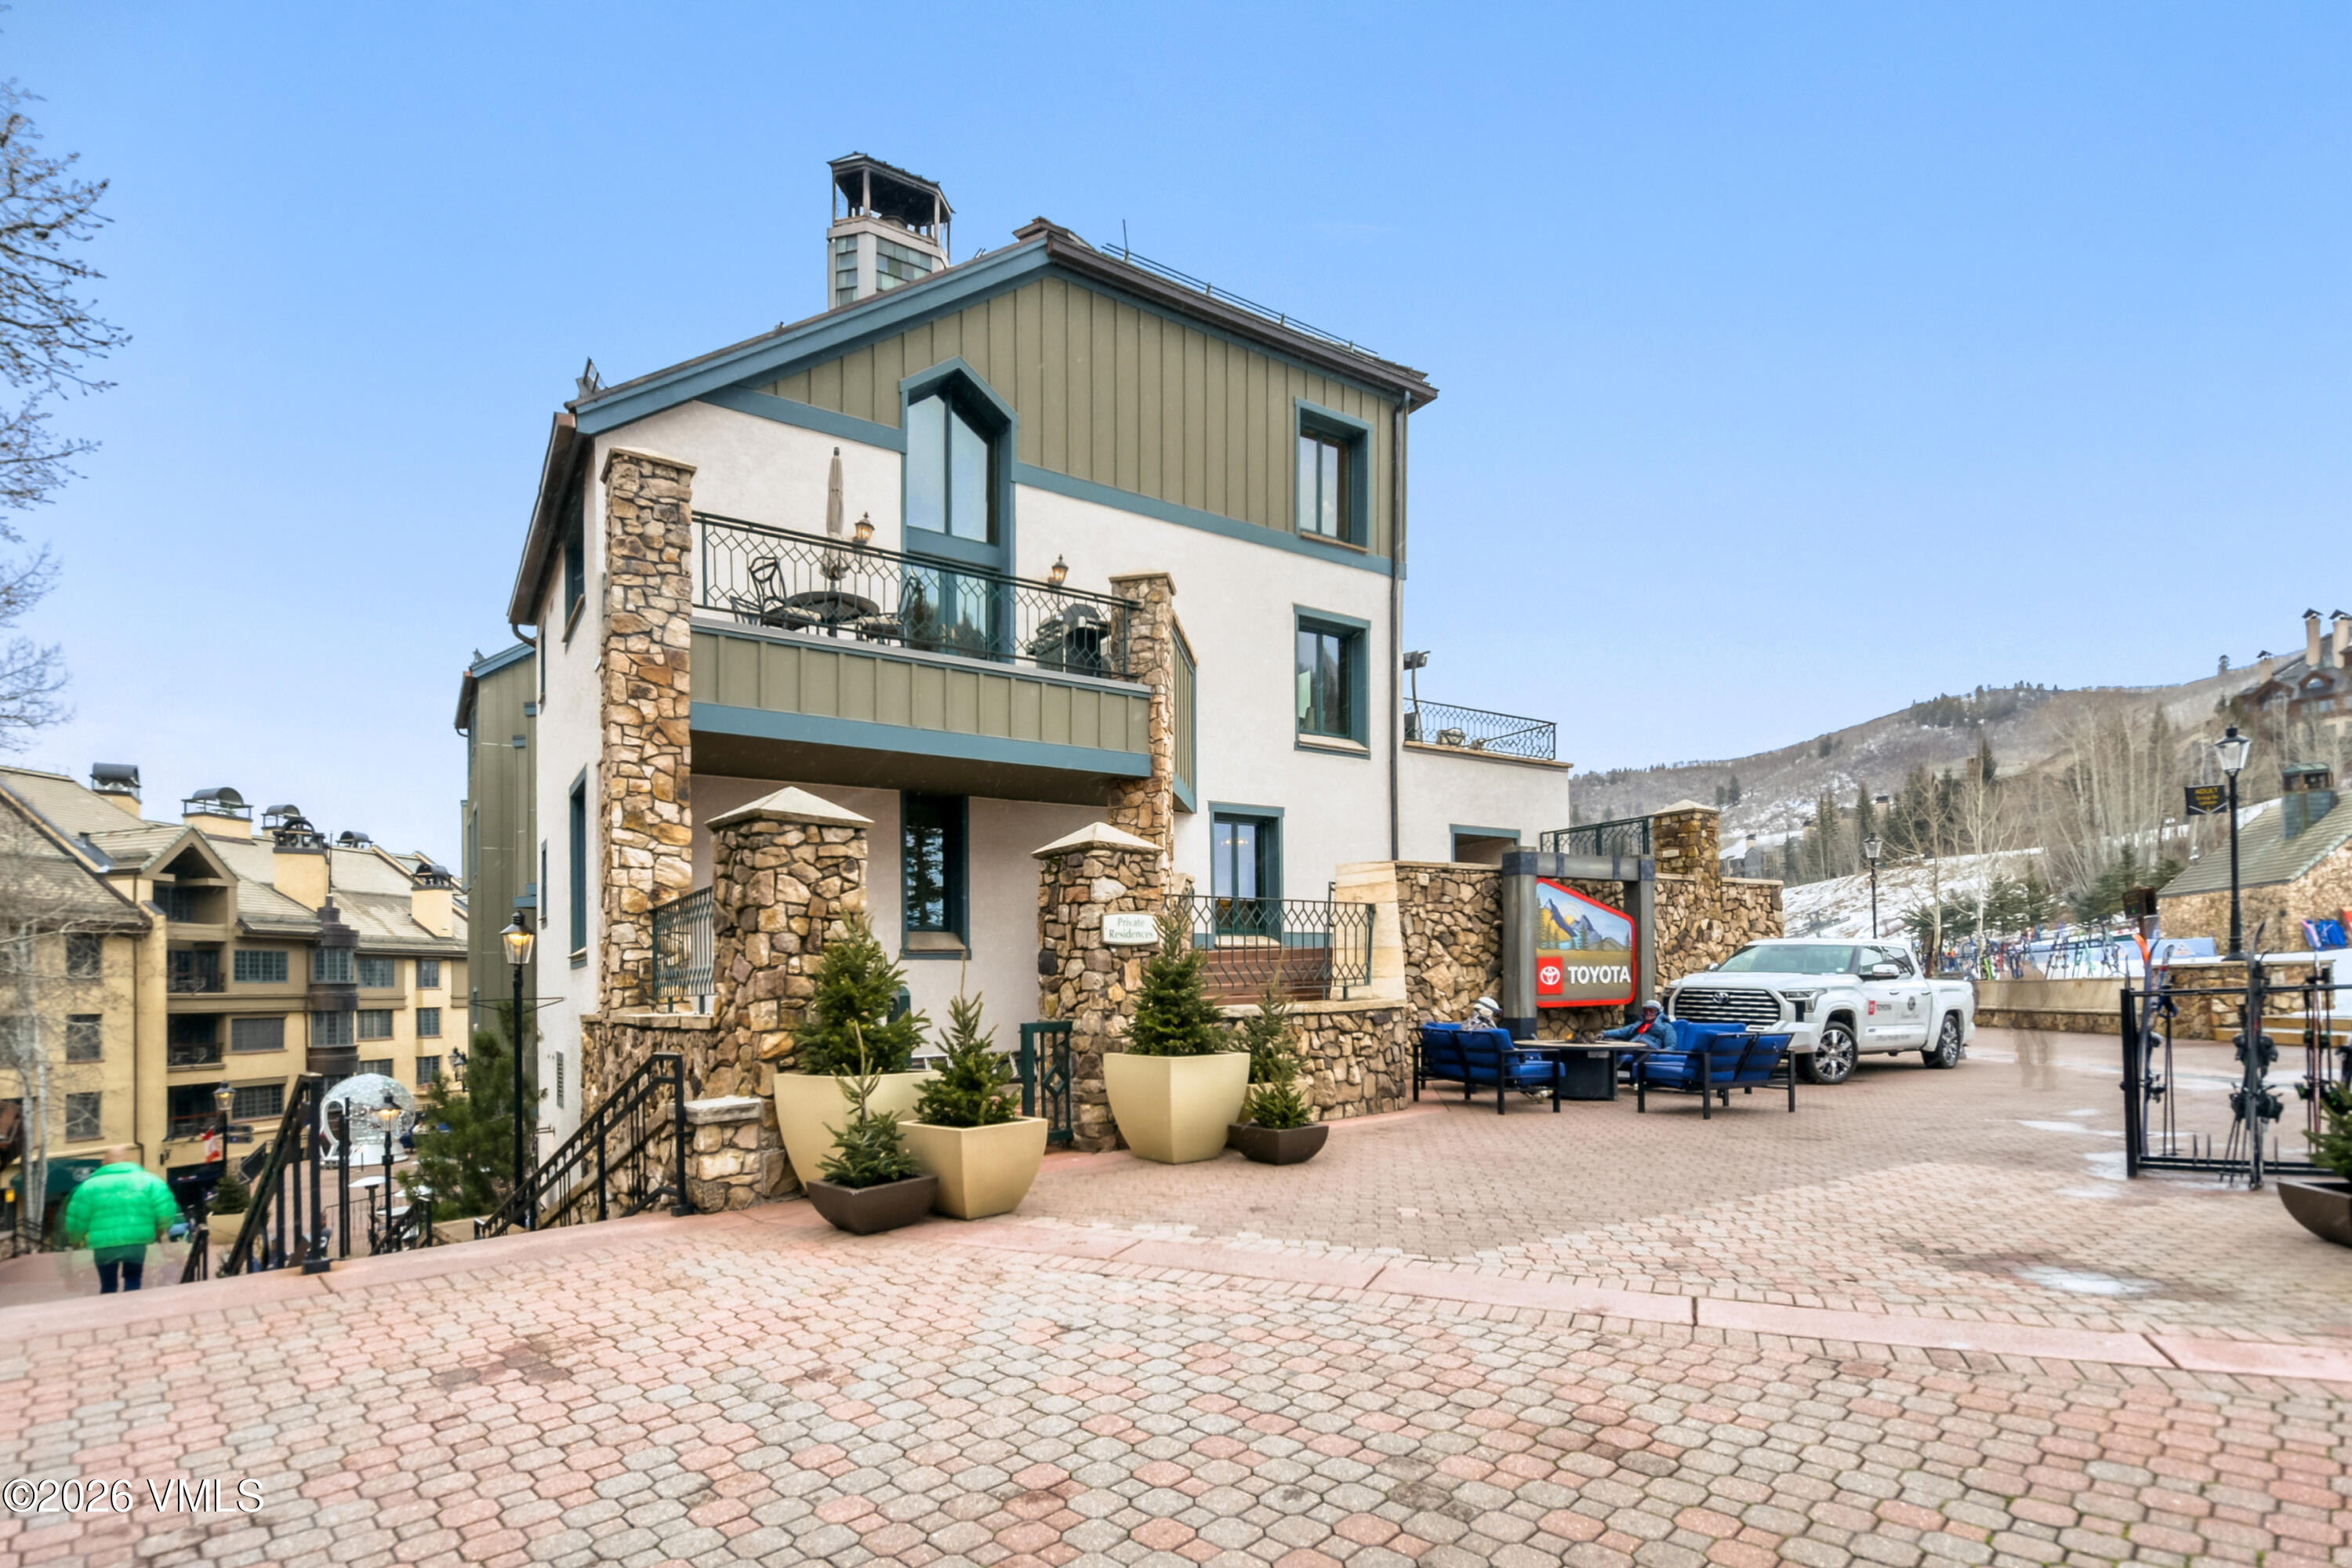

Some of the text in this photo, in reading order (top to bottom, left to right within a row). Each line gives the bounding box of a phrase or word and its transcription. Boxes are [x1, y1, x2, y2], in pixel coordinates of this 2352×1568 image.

[1117, 917, 1145, 927] Private
[1109, 928, 1154, 938] Residences
[1567, 965, 1632, 985] TOYOTA
